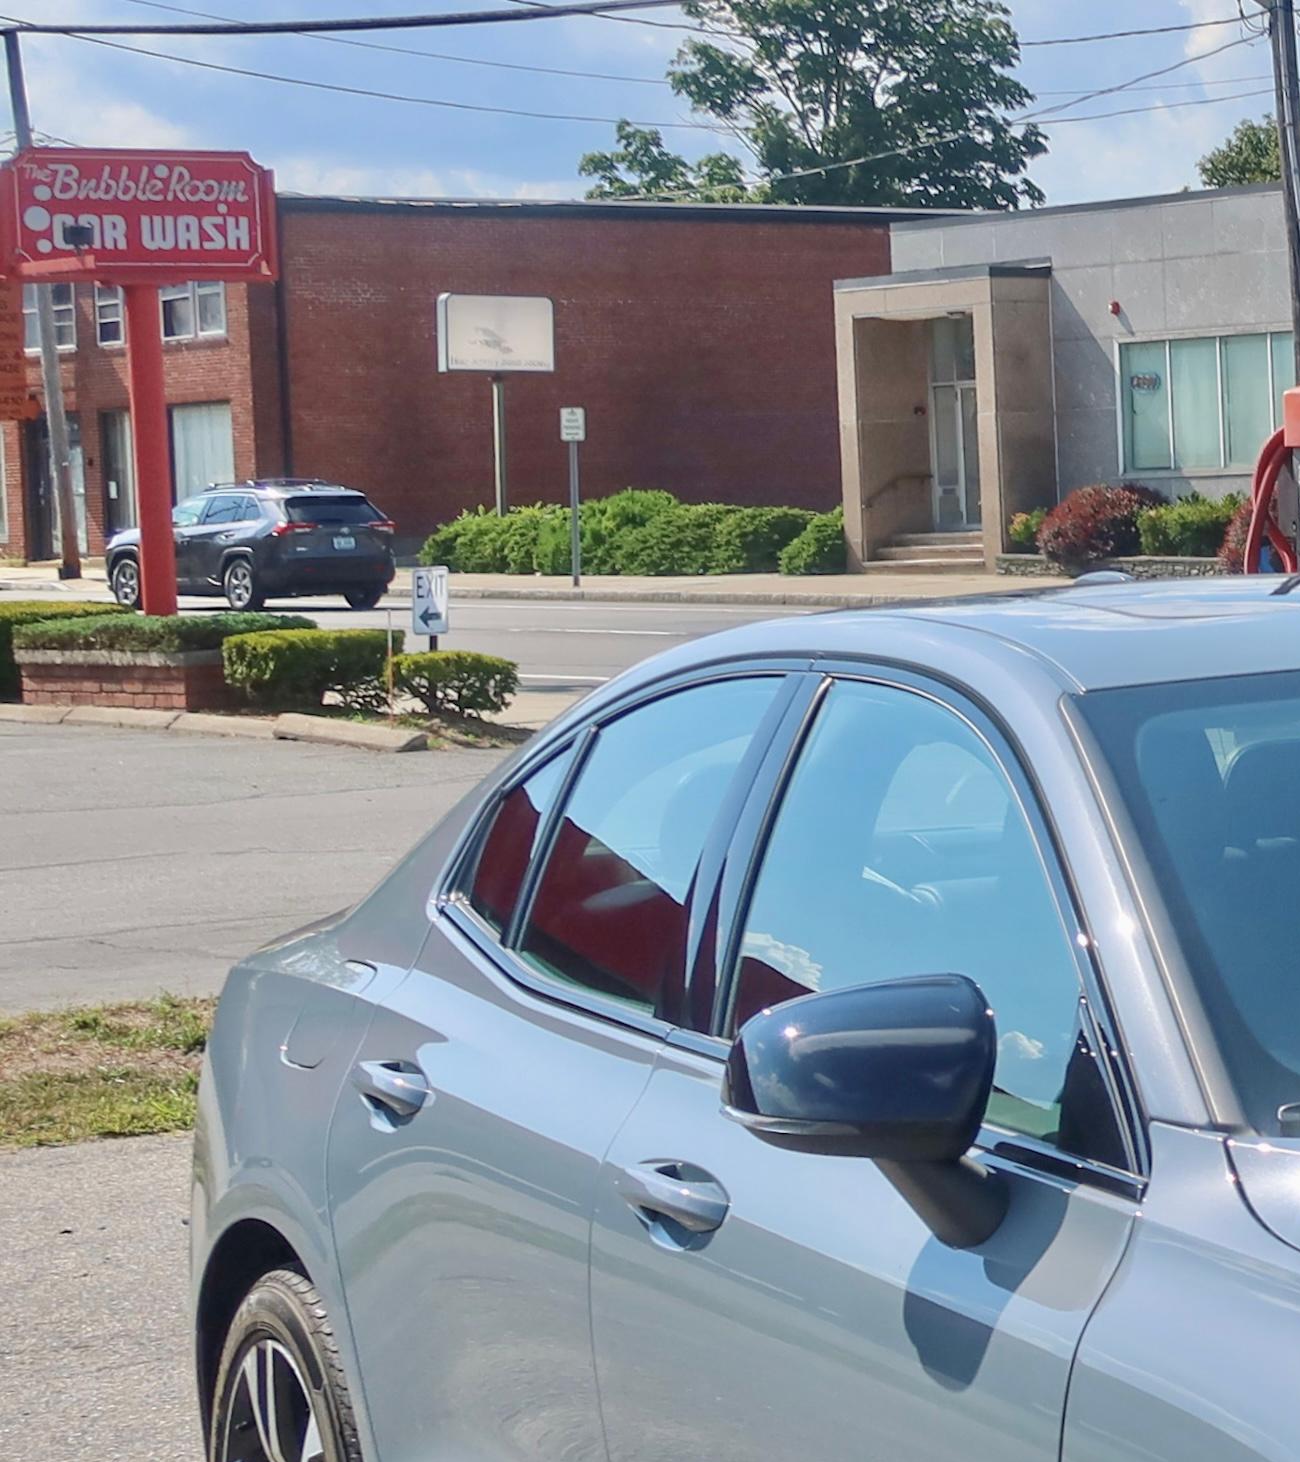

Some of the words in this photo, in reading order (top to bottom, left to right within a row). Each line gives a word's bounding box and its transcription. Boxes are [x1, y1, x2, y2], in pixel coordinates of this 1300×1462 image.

[23, 163, 51, 181] The
[49, 163, 164, 201] Bubble
[165, 165, 249, 202] Room
[140, 214, 250, 250] WASH
[416, 574, 445, 598] EXIT
